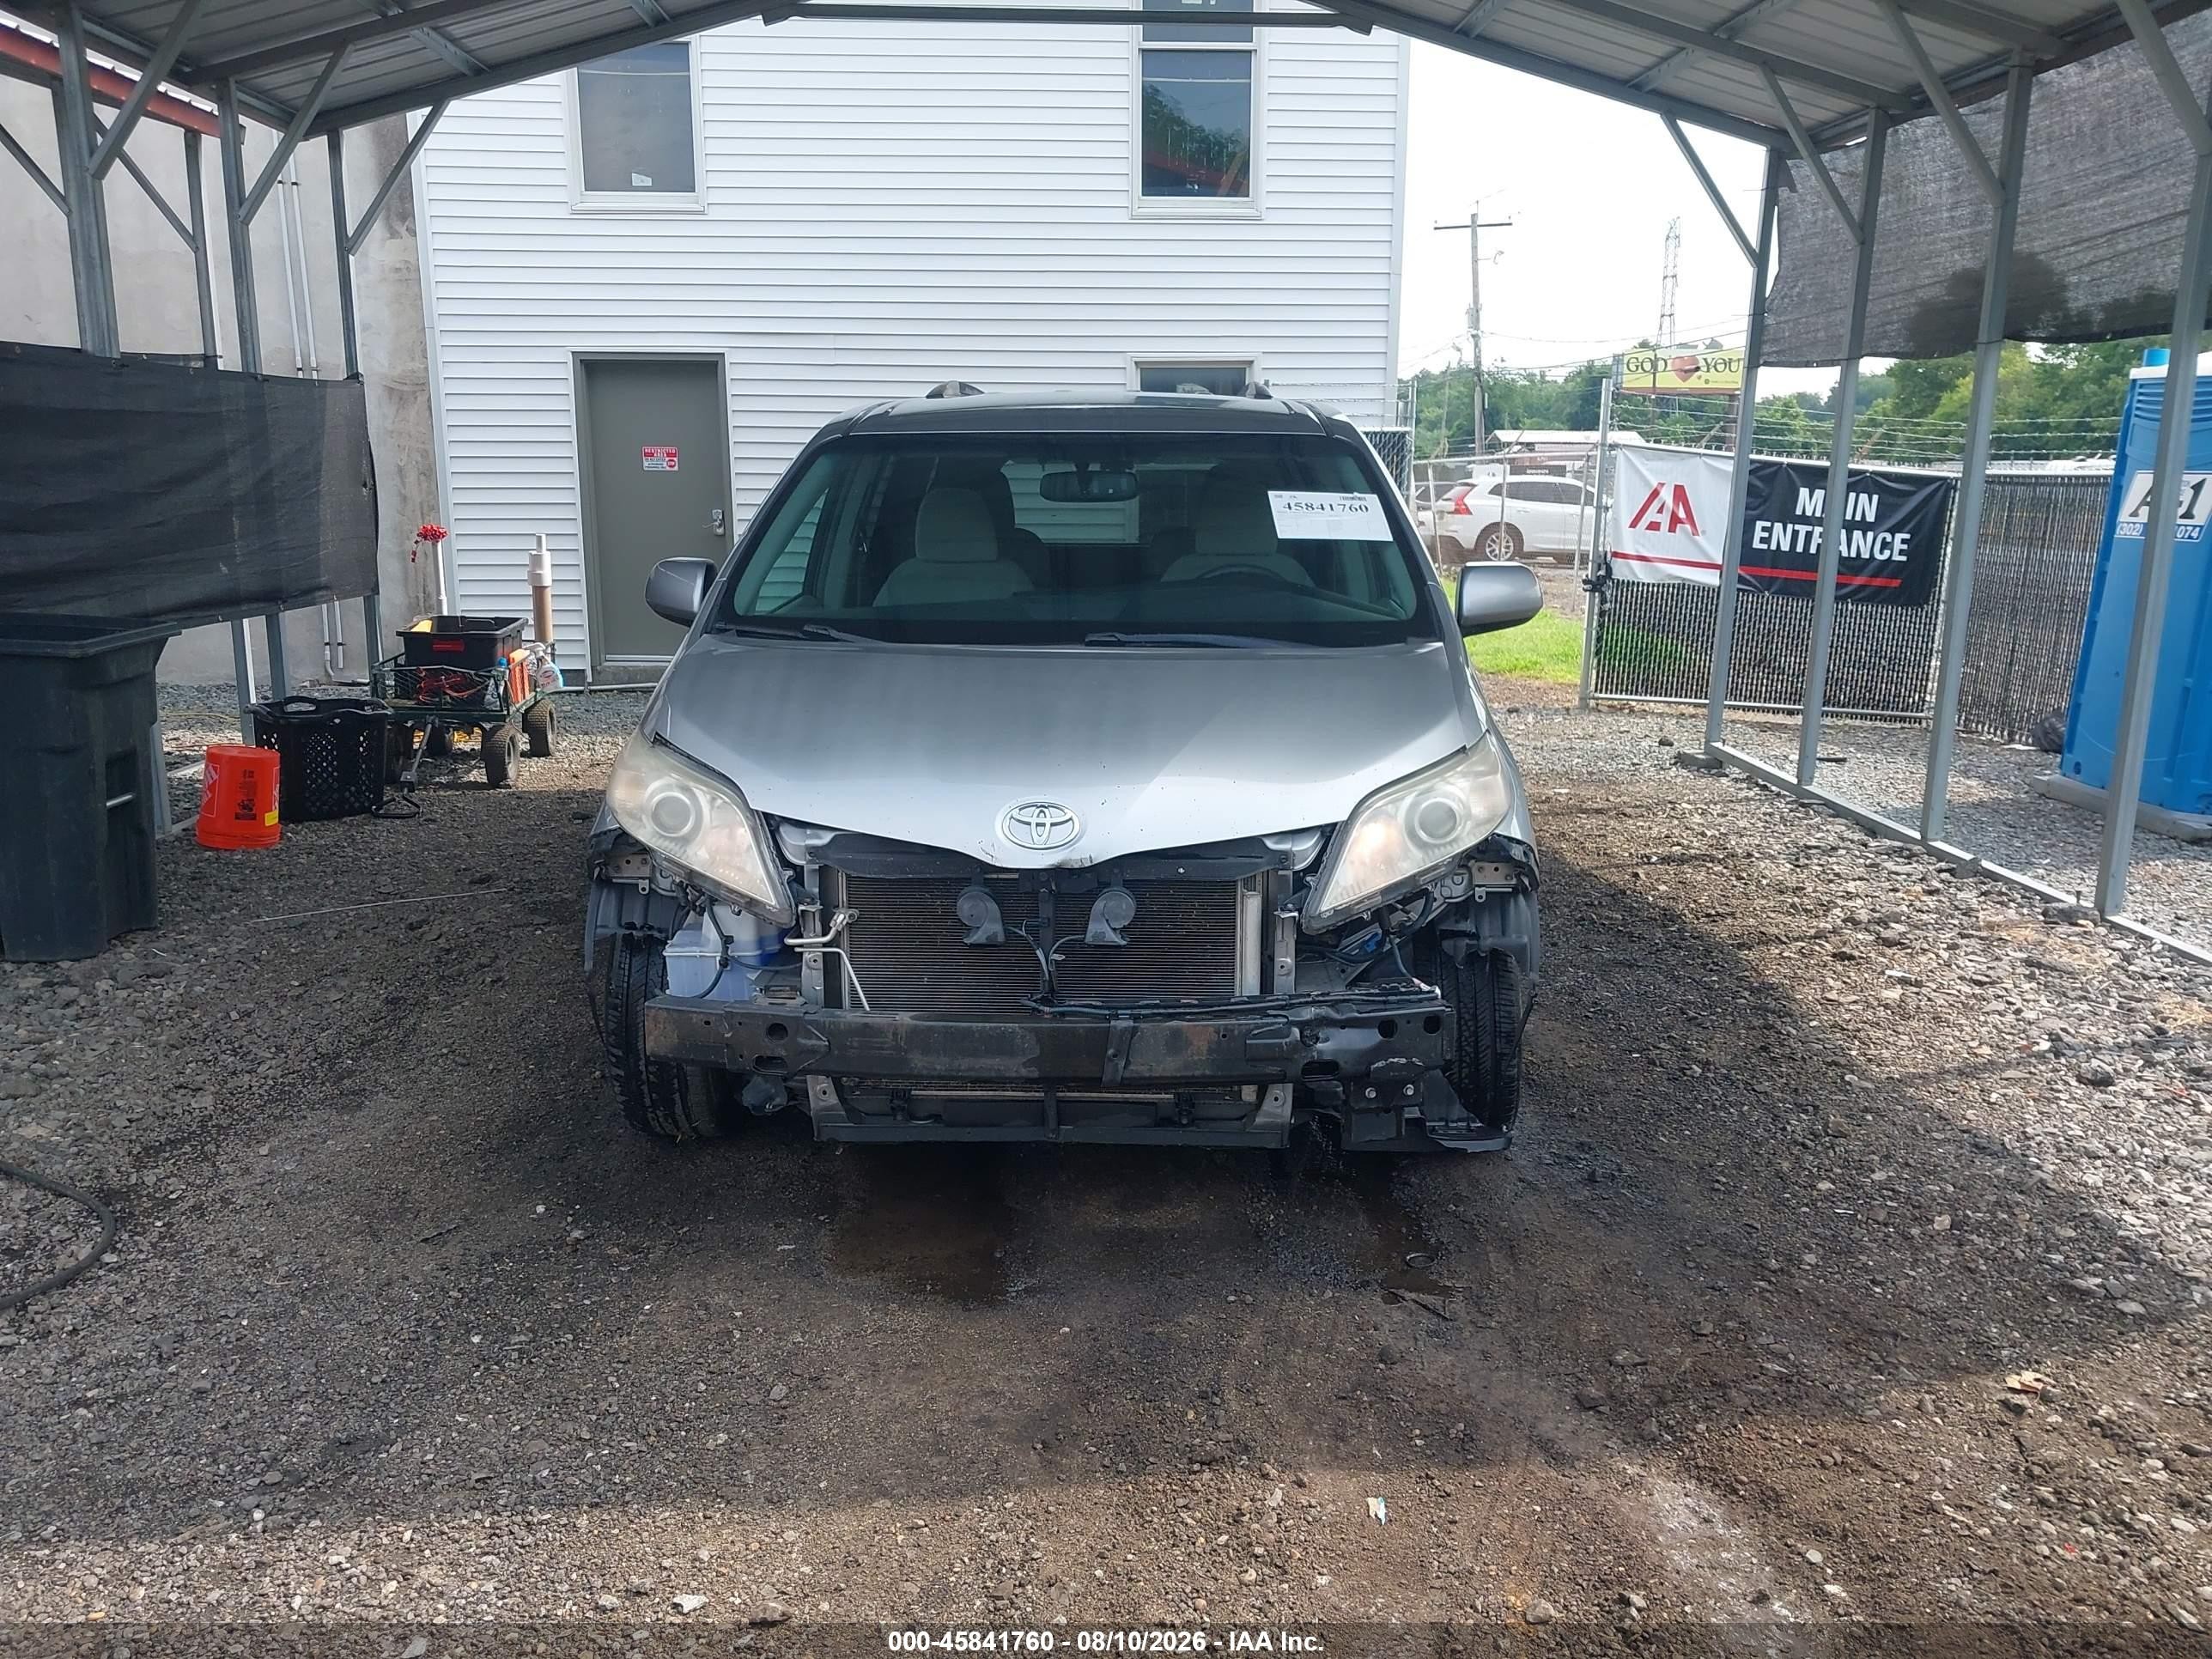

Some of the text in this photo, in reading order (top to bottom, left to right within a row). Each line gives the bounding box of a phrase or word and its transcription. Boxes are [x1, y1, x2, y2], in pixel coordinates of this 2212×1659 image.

[1626, 356, 1740, 374] GOD YOU
[1283, 501, 1370, 514] 45841760
[1795, 487, 1880, 523] MIN
[2116, 523, 2144, 536] (302)
